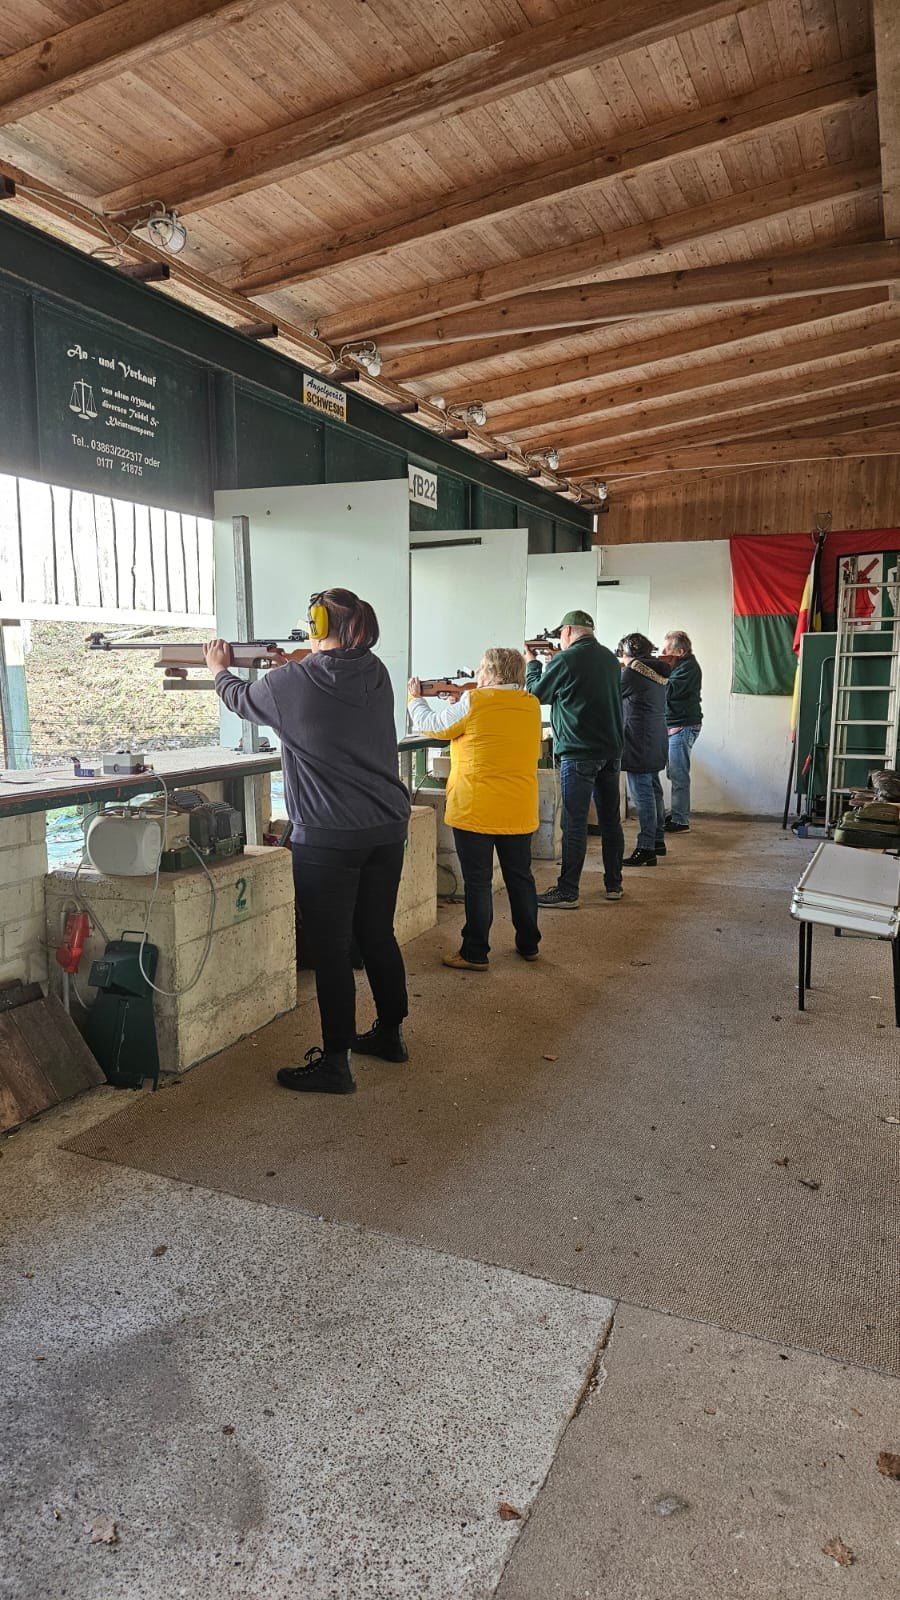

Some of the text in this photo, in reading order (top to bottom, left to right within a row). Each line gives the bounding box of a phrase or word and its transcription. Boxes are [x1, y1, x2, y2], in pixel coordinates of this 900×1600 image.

[67, 344, 88, 360] An
[98, 357, 115, 371] und
[118, 361, 157, 387] Verkauf
[101, 386, 113, 396] von
[306, 379, 344, 402] Angelgeräte
[96, 456, 114, 470] 0177
[144, 456, 160, 468] oder
